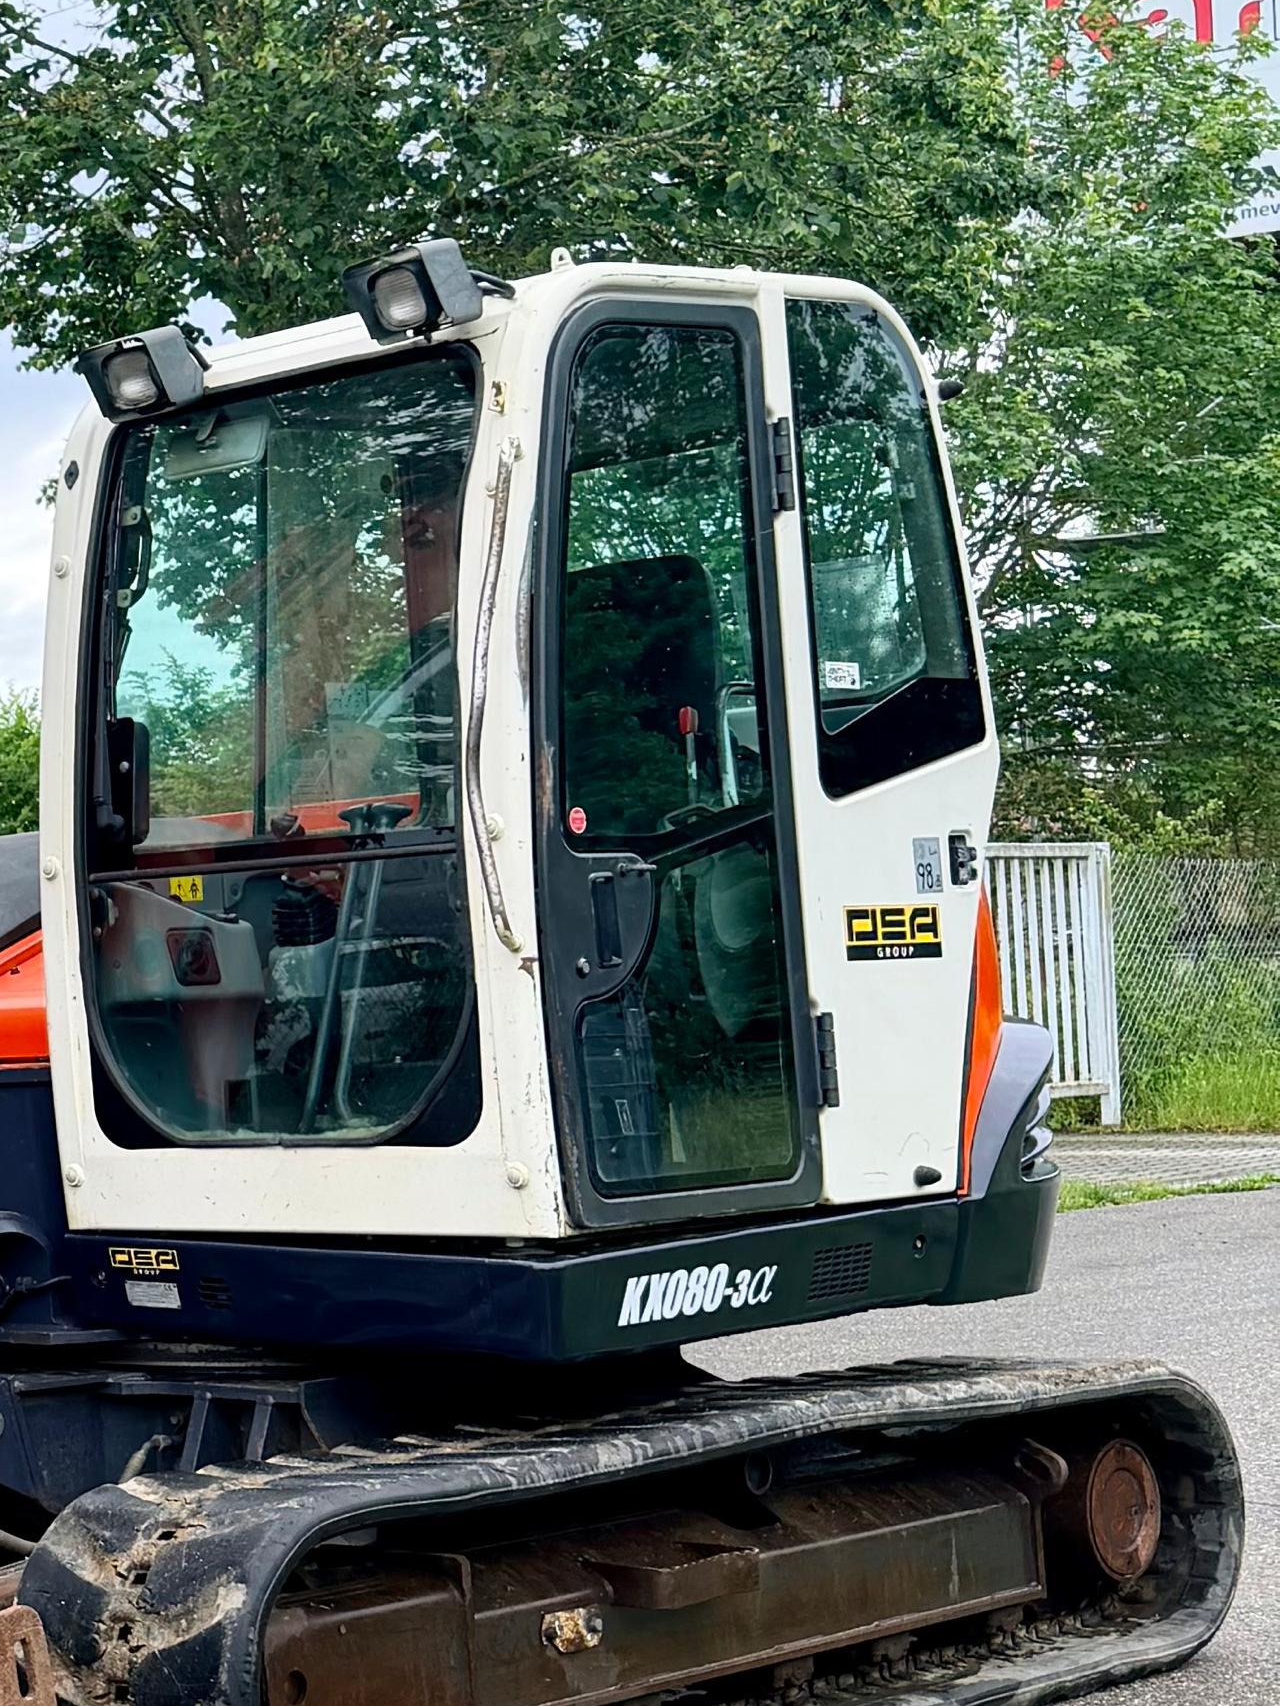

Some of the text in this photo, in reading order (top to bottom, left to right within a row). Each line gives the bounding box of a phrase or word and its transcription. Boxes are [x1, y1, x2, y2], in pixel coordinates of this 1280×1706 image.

[917, 862, 934, 890] 98
[846, 906, 939, 942] DEA
[876, 945, 915, 958] GROUP
